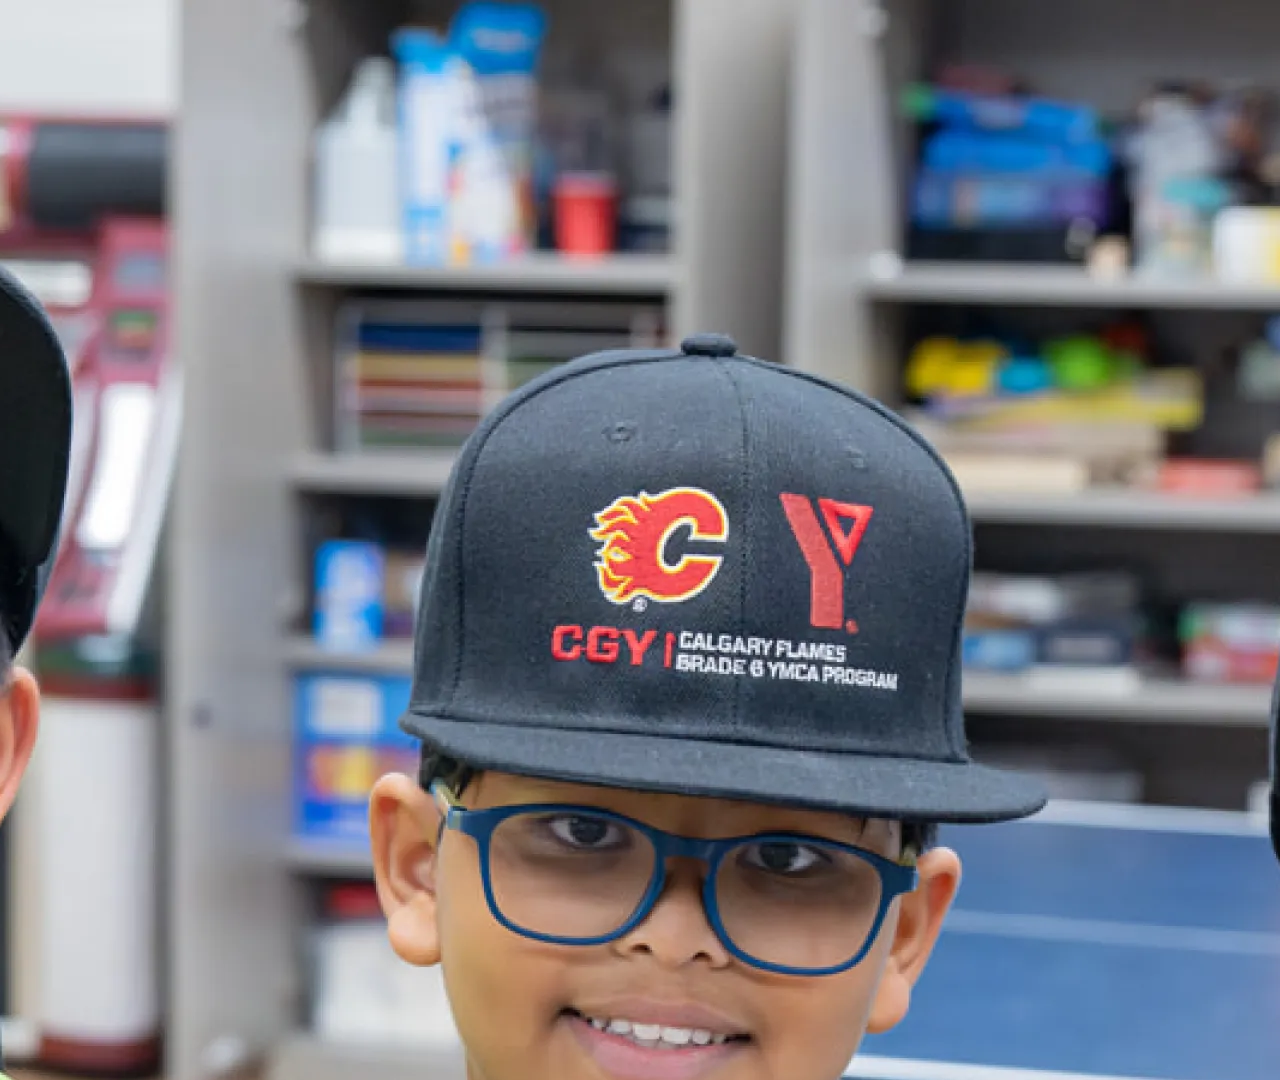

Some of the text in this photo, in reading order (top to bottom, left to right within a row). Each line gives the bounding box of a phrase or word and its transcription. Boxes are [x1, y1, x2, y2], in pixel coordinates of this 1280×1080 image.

[587, 487, 730, 603] C
[779, 492, 873, 629] Y
[551, 624, 657, 666] CGY
[679, 630, 847, 663] CALGARY FLAMES
[675, 652, 898, 690] GRADE 6 YMCA PROGRAM
